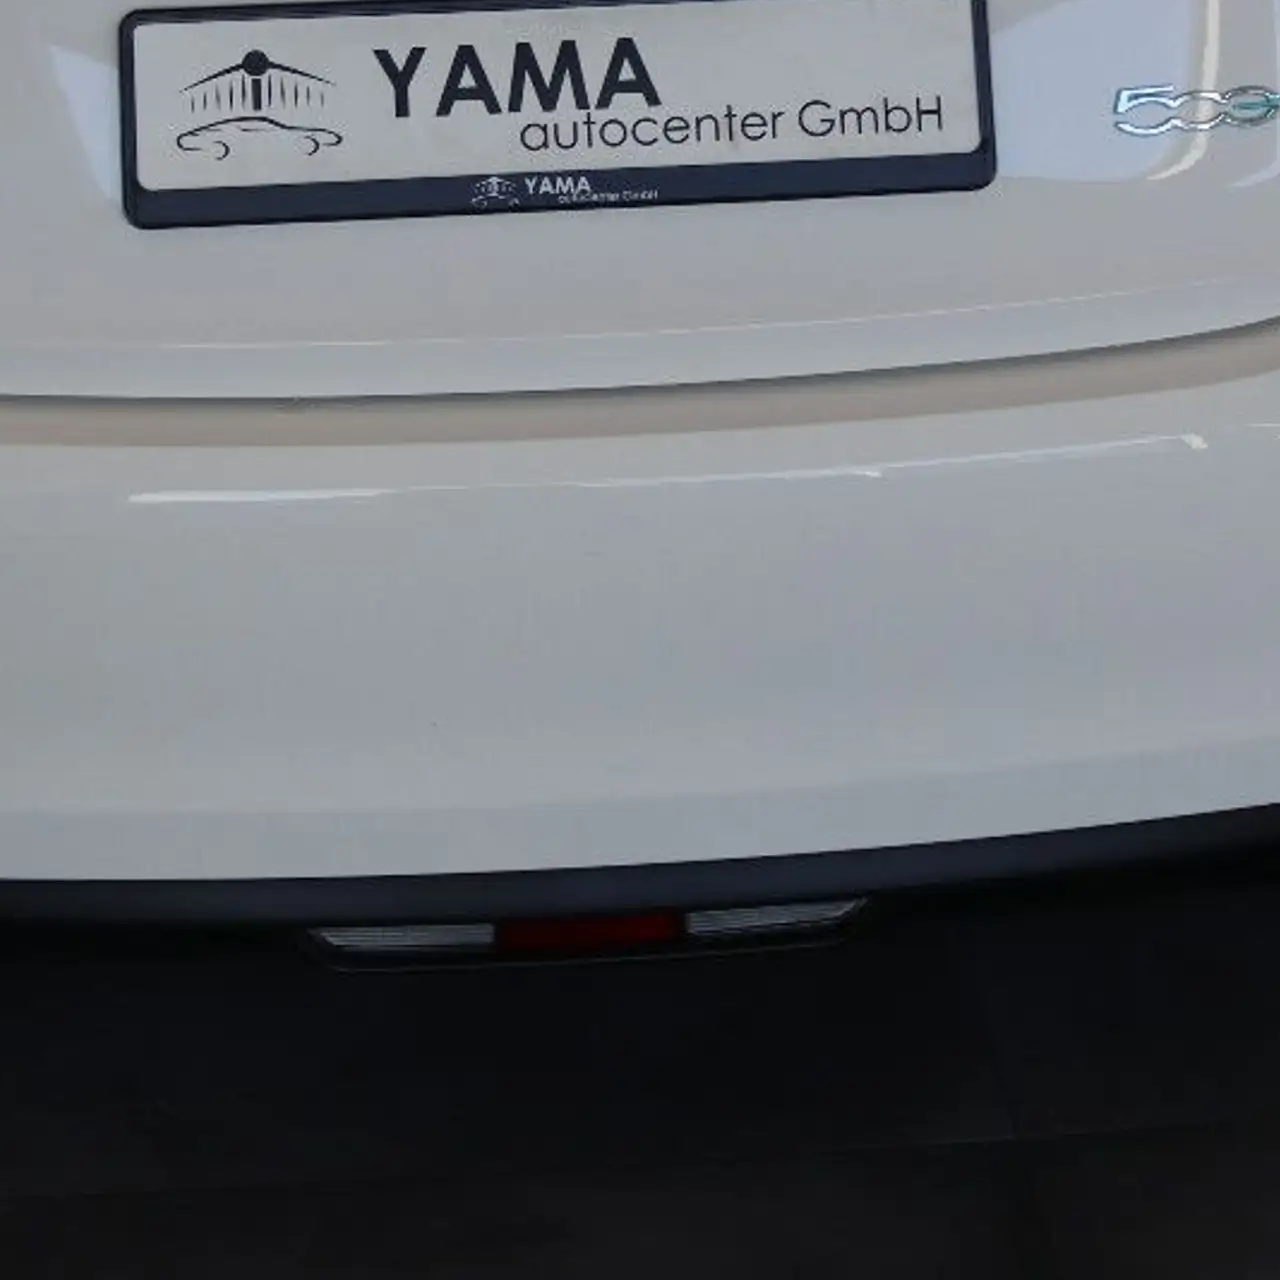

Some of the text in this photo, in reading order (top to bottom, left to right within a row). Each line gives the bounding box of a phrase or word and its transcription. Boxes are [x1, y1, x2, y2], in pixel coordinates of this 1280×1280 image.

[372, 36, 662, 118] YAMA
[519, 95, 943, 152] autocenter GmbH
[524, 176, 592, 195] YAMA
